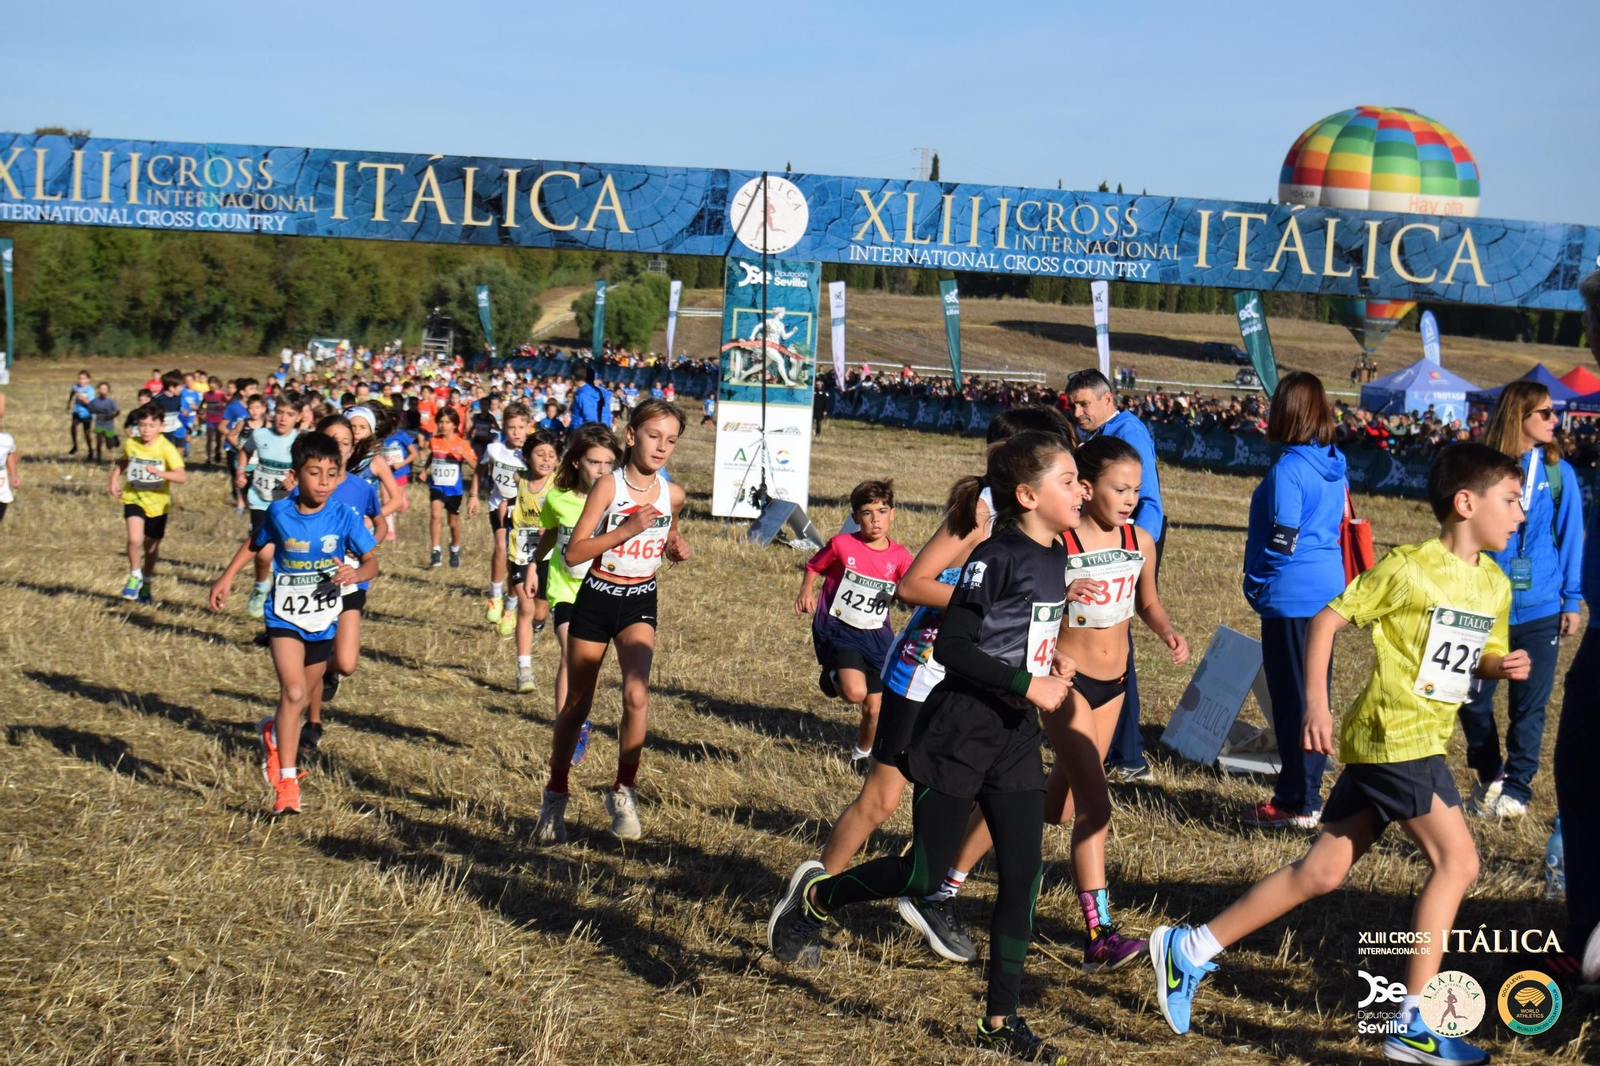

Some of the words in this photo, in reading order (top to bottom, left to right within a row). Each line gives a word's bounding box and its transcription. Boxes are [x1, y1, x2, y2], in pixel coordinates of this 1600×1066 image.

[146, 154, 274, 190] CROSS
[146, 190, 319, 213] INTERNACIONAL
[329, 154, 635, 234] ITÁLICA
[135, 210, 194, 228] CROSS
[196, 213, 288, 232] COUNTRY
[850, 188, 1012, 250] XLIII
[1014, 199, 1140, 238] CROSS
[1014, 233, 1182, 261] INTERNACIONAL
[1193, 205, 1490, 288] ITÁLICA
[849, 244, 999, 269] INTERNATIONAL
[1002, 254, 1059, 274] CROSS
[1062, 258, 1152, 280] COUNTRY
[773, 277, 808, 288] Sevilla
[432, 468, 457, 478] 4107
[610, 538, 665, 560] 4463
[1086, 551, 1128, 565] ITÁLICA
[585, 577, 626, 597] NIKE
[625, 581, 657, 597] PRO
[282, 589, 338, 616] 4216
[840, 589, 888, 616] 4250
